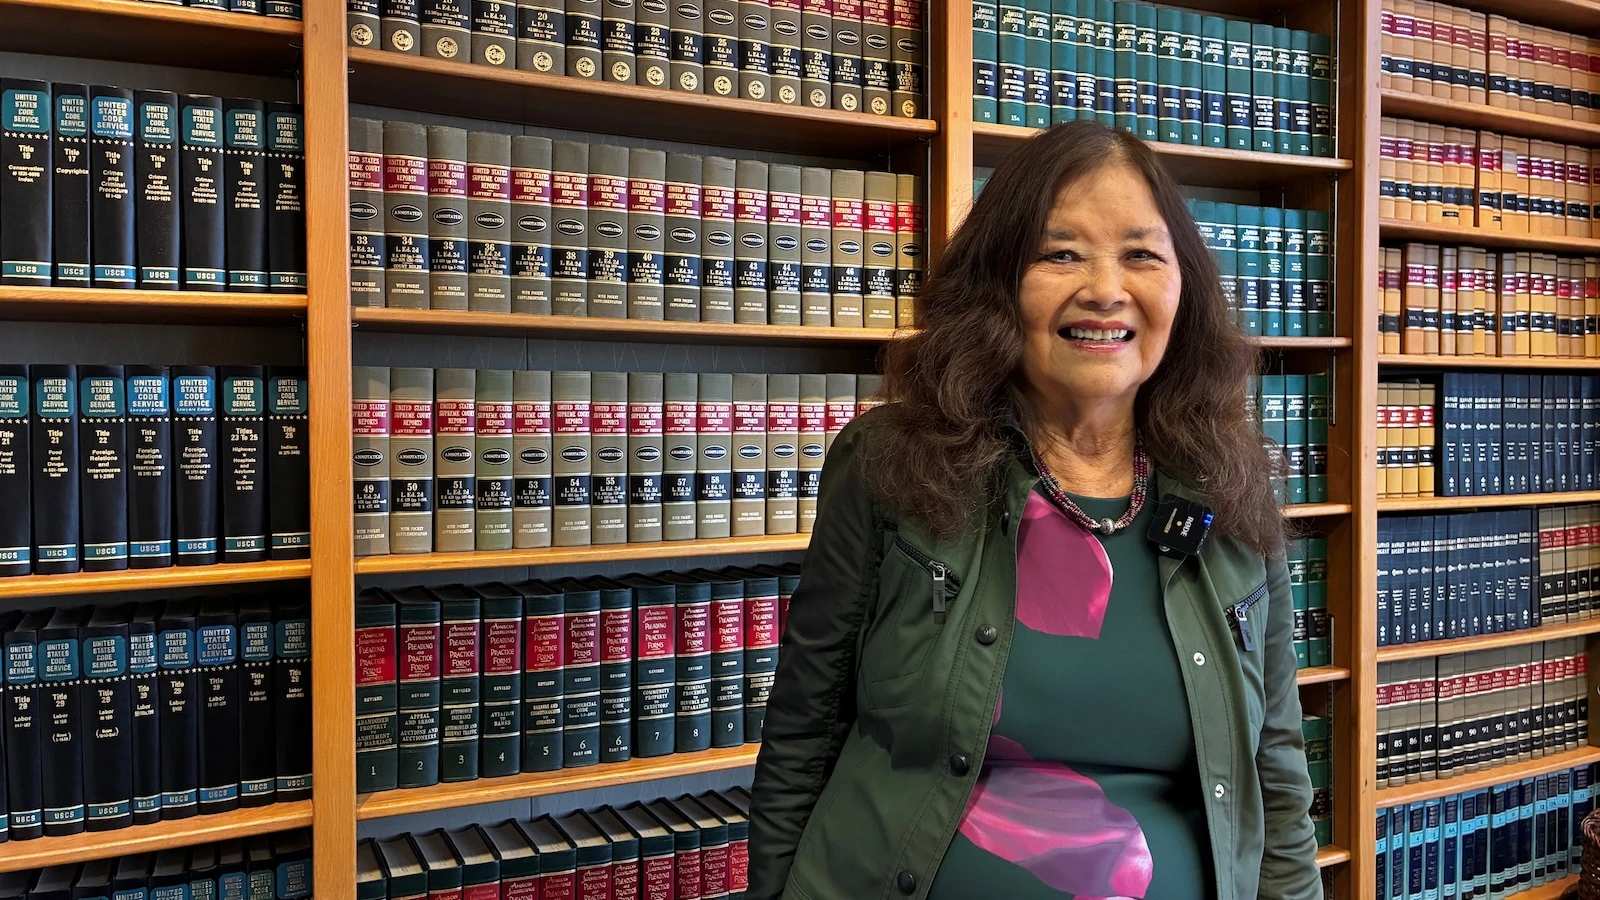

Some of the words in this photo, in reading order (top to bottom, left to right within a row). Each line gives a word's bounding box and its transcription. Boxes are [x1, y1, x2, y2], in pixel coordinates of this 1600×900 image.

[490, 4, 500, 12] 19
[537, 12, 548, 20] 20
[580, 20, 590, 29] 21
[650, 27, 660, 36] 23
[402, 236, 413, 245] 34
[443, 241, 454, 250] 35
[484, 243, 495, 252] 36
[527, 246, 537, 254] 37
[566, 251, 576, 260] 38
[604, 251, 614, 259] 39
[643, 253, 652, 262] 40
[453, 480, 463, 489] 51
[570, 478, 579, 486] 54
[644, 478, 653, 487] 56
[677, 478, 686, 486] 57
[711, 476, 720, 484] 58
[407, 483, 418, 491] 50
[490, 482, 501, 490] 52
[357, 717, 389, 726] ABANDONED
[728, 723, 733, 731] 9
[616, 736, 622, 745] 6
[655, 732, 659, 740] 7
[580, 740, 586, 749] 6
[543, 746, 549, 755] 5
[459, 755, 464, 764] 3
[499, 752, 505, 762] 4
[417, 761, 423, 770] 2
[371, 766, 376, 775] 1
[99, 806, 118, 814] USCS
